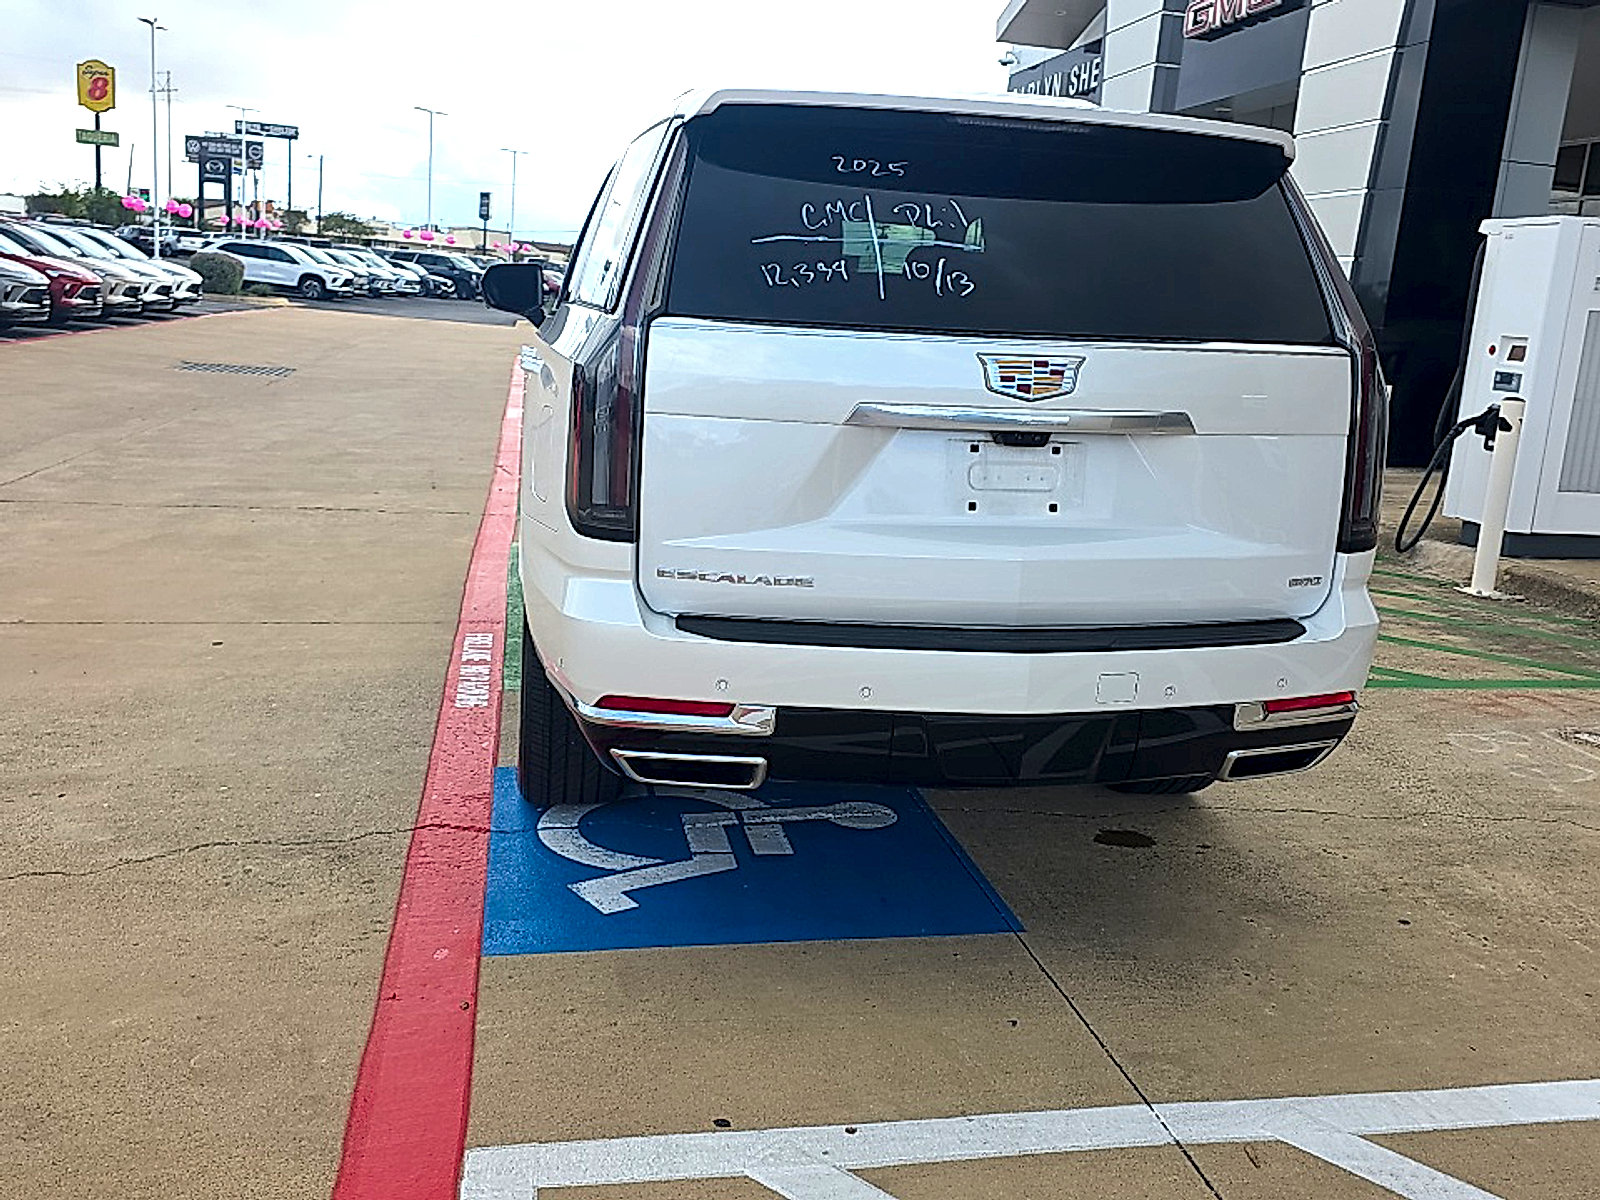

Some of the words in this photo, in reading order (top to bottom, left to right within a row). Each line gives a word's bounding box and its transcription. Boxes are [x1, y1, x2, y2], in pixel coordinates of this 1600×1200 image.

[82, 64, 109, 79] Super
[88, 77, 109, 101] 8
[832, 156, 908, 177] 2025
[904, 258, 975, 297] 10/13
[656, 567, 815, 588] ESCALADE
